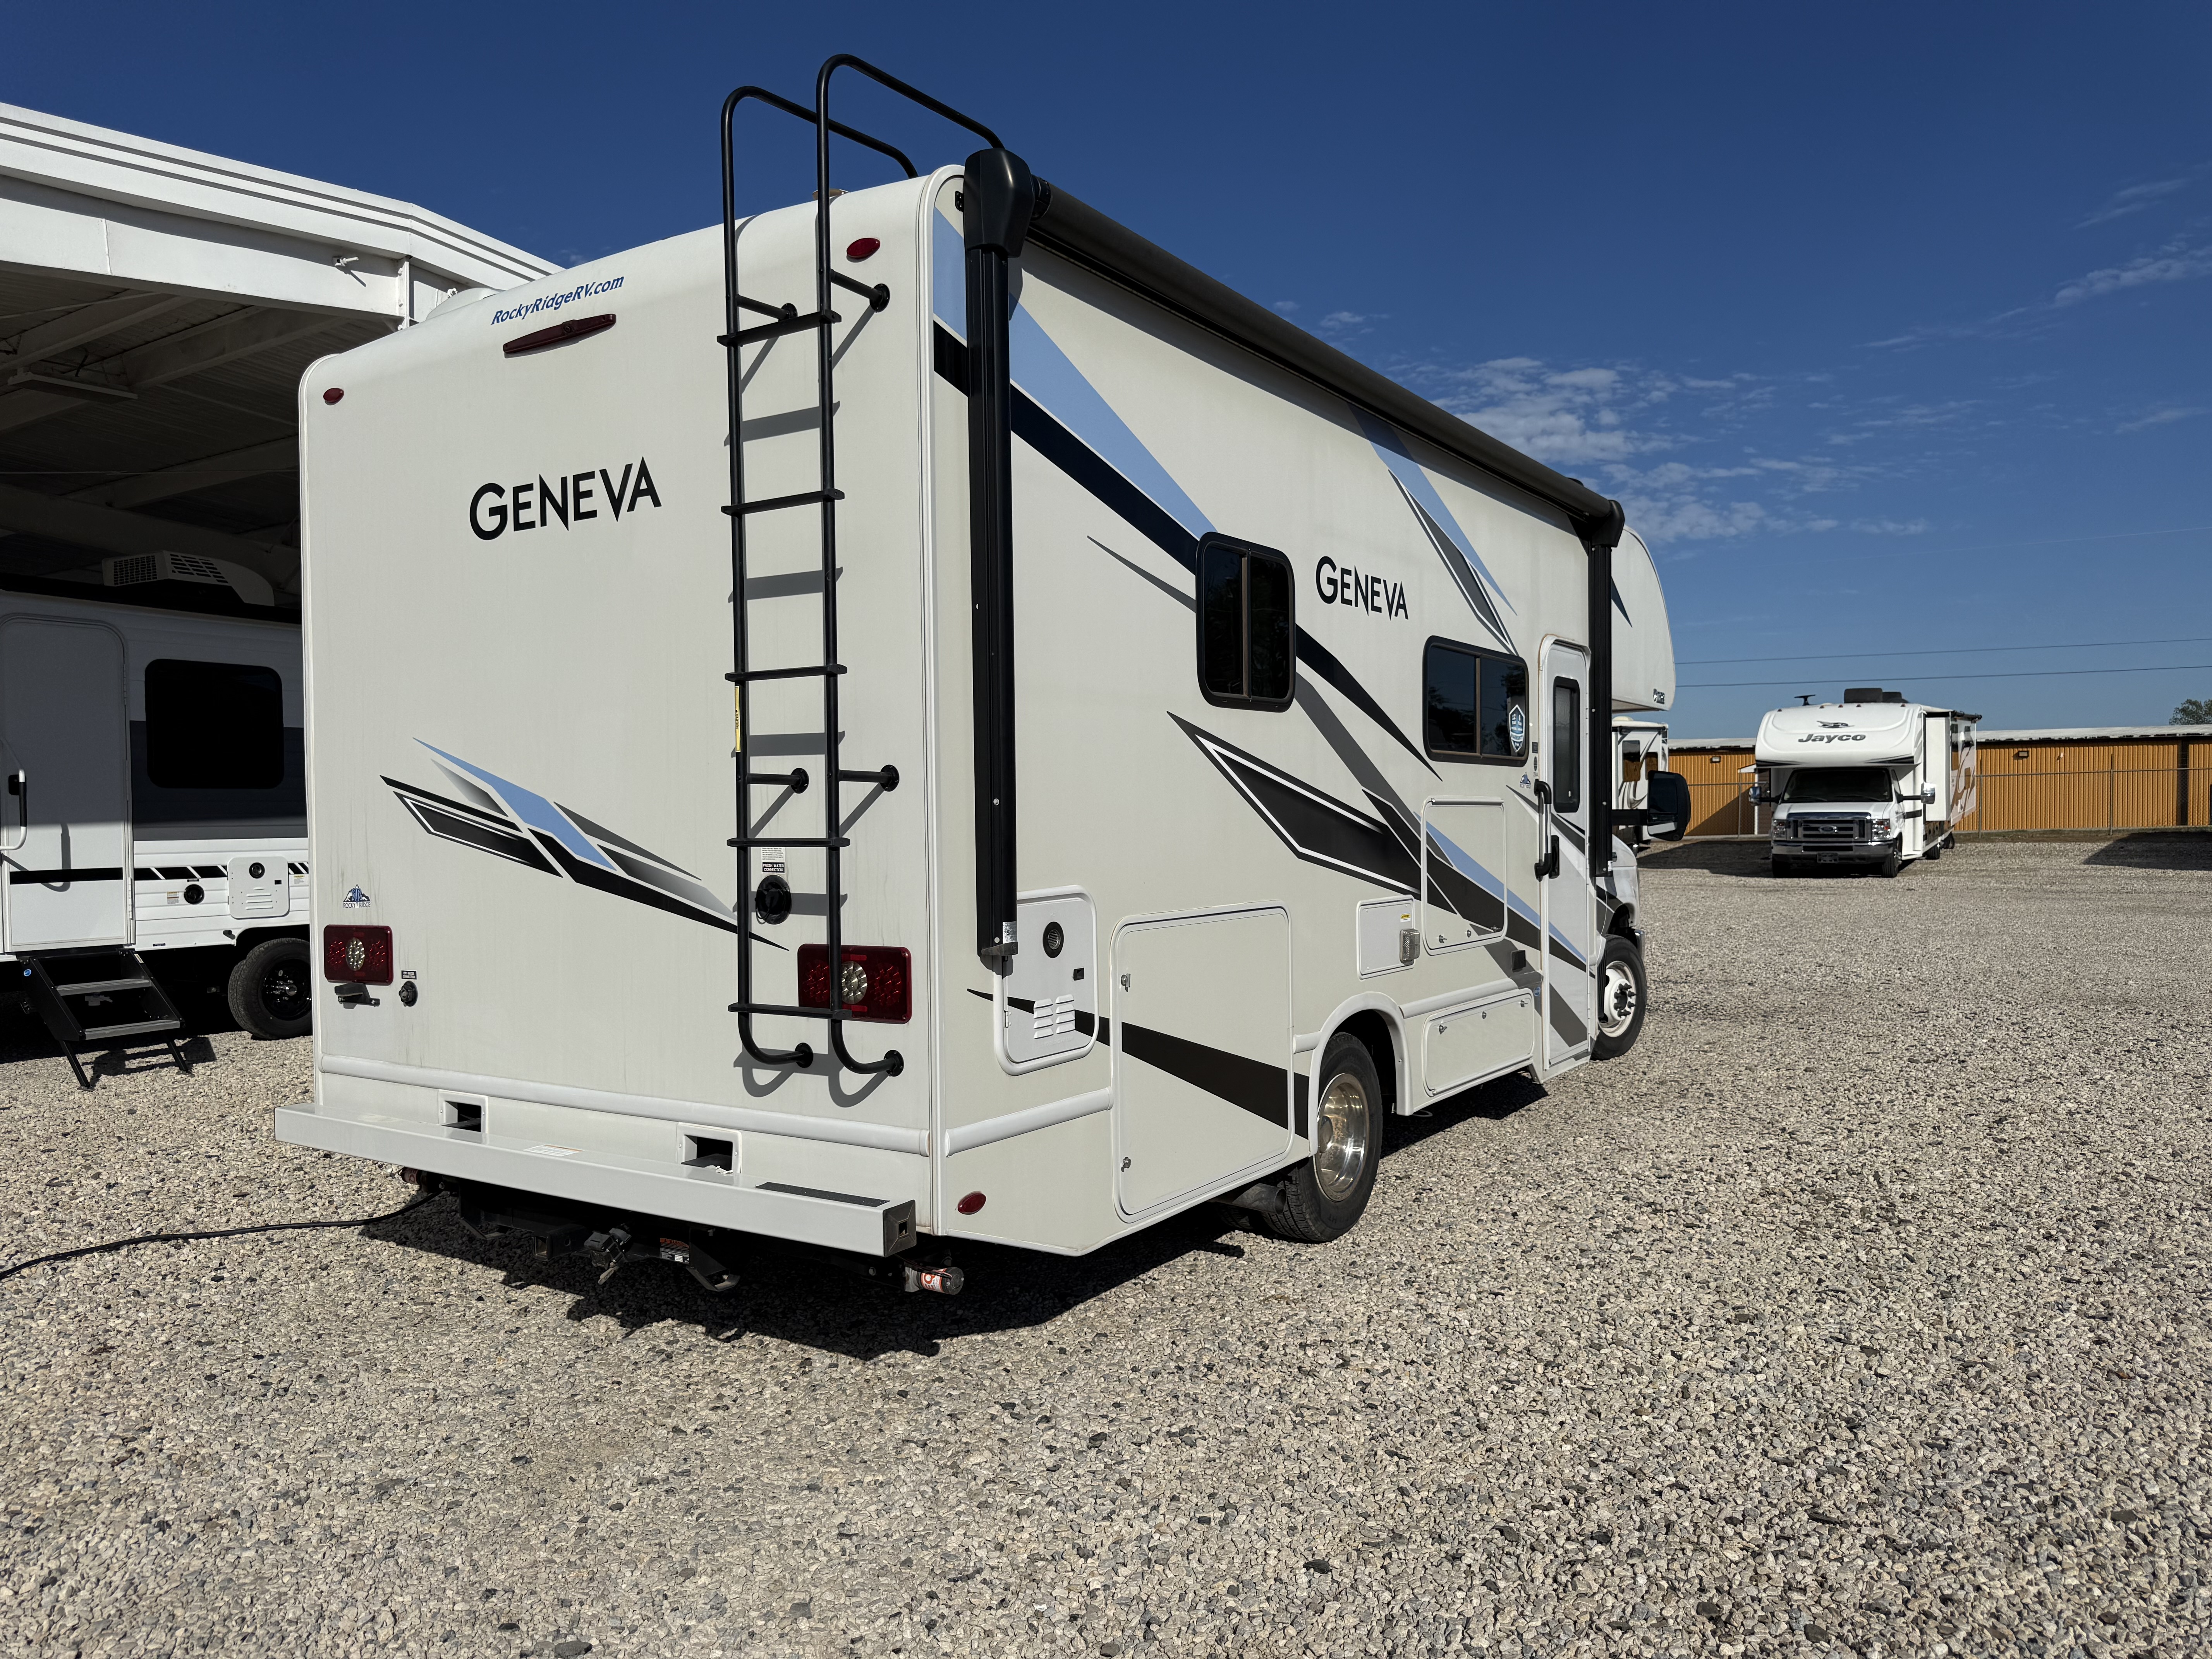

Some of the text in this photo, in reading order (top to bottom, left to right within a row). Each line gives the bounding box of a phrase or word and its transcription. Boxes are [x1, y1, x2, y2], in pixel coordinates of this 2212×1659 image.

[491, 276, 624, 325] RockyRidgeRV.com
[470, 456, 662, 540] GENEVA
[1316, 556, 1408, 621] GENEVA
[1798, 734, 1866, 744] Jayco
